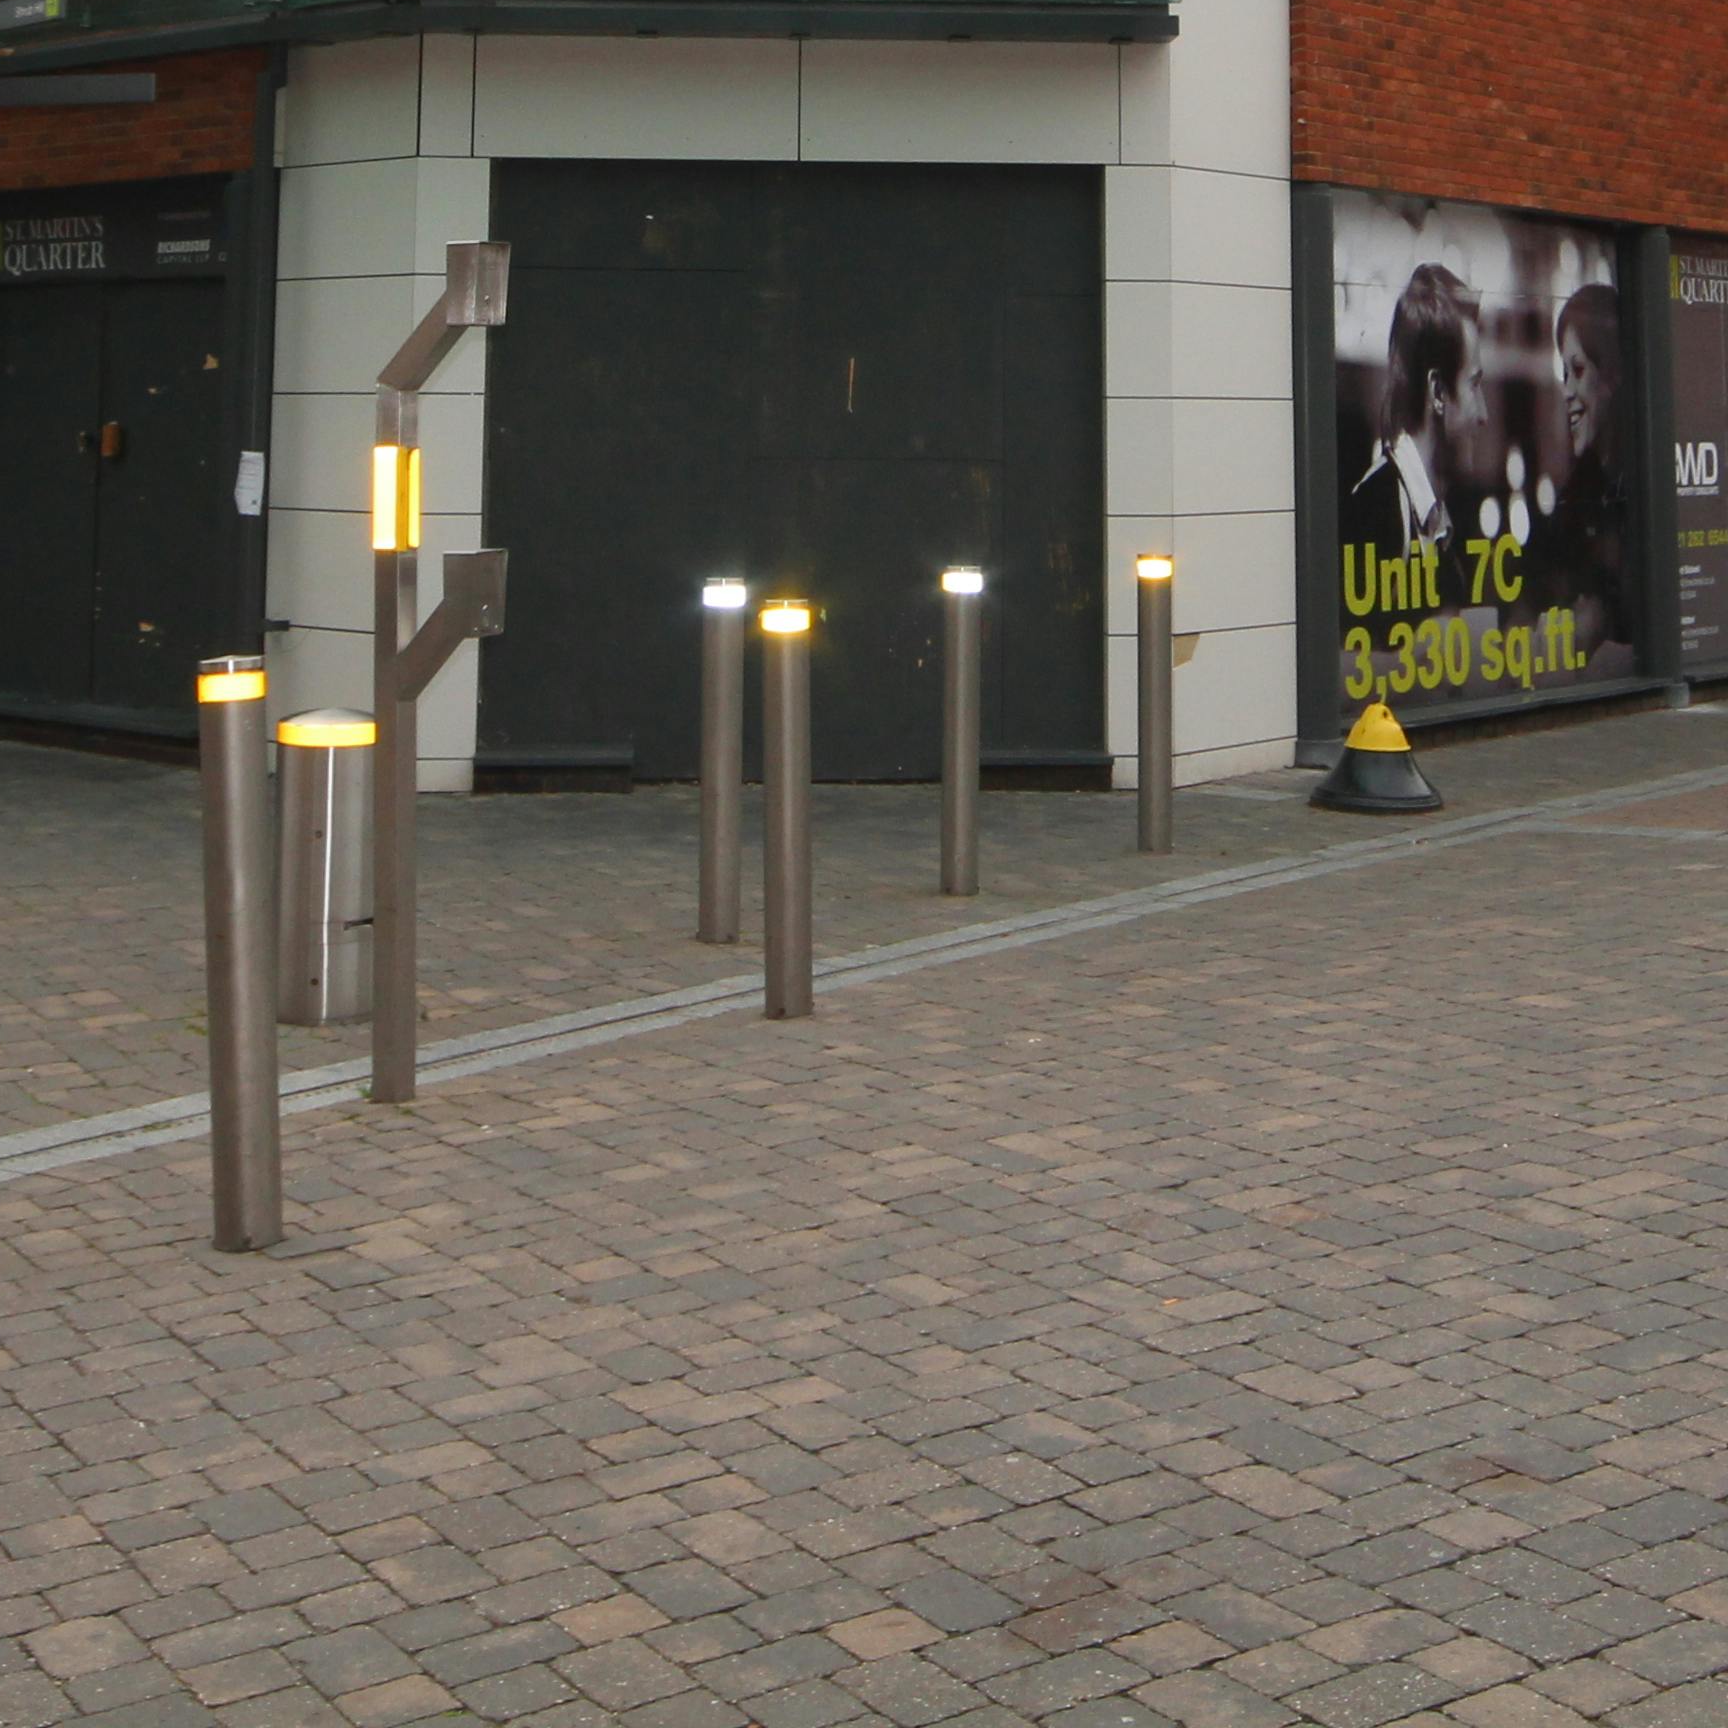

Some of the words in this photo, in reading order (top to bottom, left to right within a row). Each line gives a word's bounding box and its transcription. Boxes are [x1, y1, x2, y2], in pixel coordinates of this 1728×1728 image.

[28, 215, 104, 240] MARTIN'S
[4, 240, 106, 276] QUARTER
[1674, 441, 1718, 485] WD
[1343, 539, 1440, 616] Unit
[1466, 533, 1523, 604] 7C
[1344, 617, 1470, 703] 3,330
[1480, 607, 1587, 688] sq.ft.
